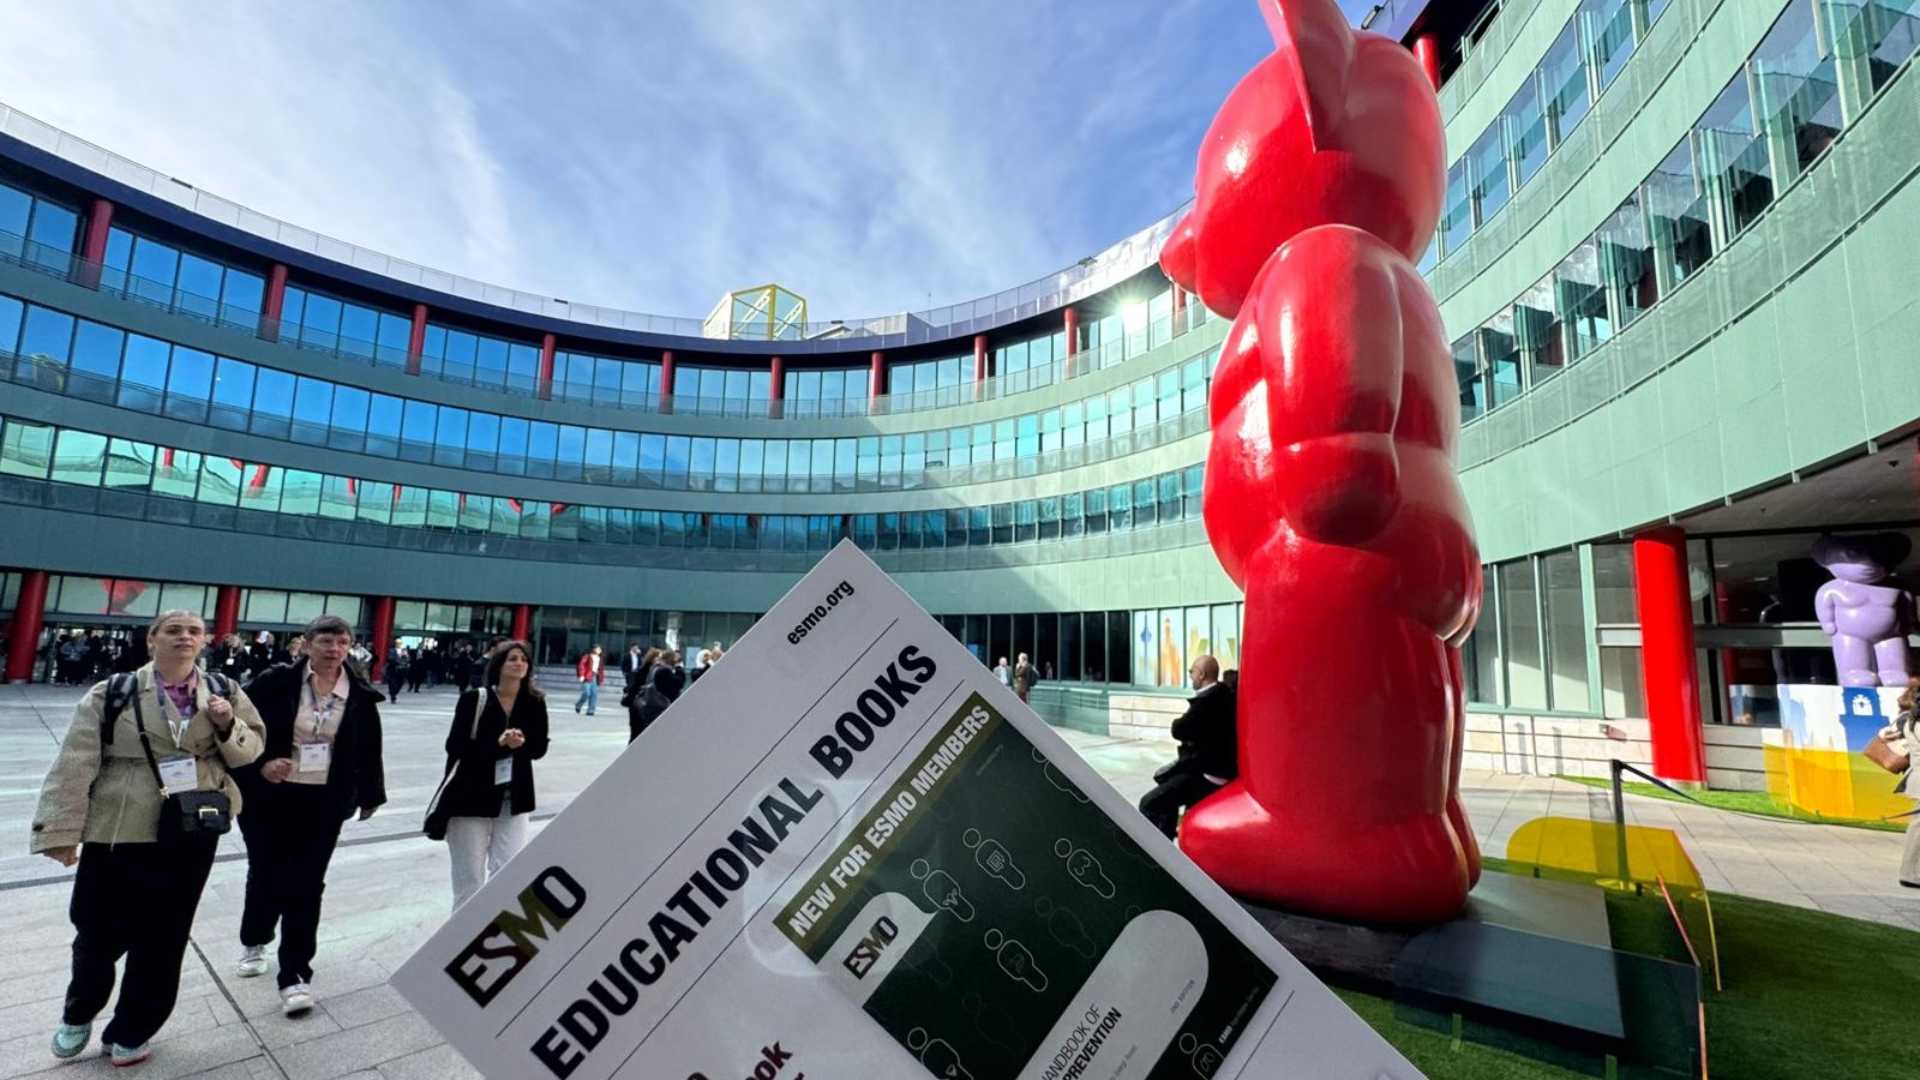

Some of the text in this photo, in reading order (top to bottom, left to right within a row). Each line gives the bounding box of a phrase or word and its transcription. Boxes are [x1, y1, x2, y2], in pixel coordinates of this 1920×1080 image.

[787, 579, 855, 645] esmo.org
[788, 883, 836, 937] NEW
[831, 844, 872, 889] FOR
[865, 791, 917, 849] ESMO
[911, 705, 990, 795] MEMBERS
[530, 645, 937, 1080] EDUCATIONAL BOOKS
[444, 865, 587, 1008] ESMO
[843, 915, 899, 980] ESMO
[1063, 1007, 1122, 1080] PREVENTION
[1085, 1003, 1100, 1024] OF
